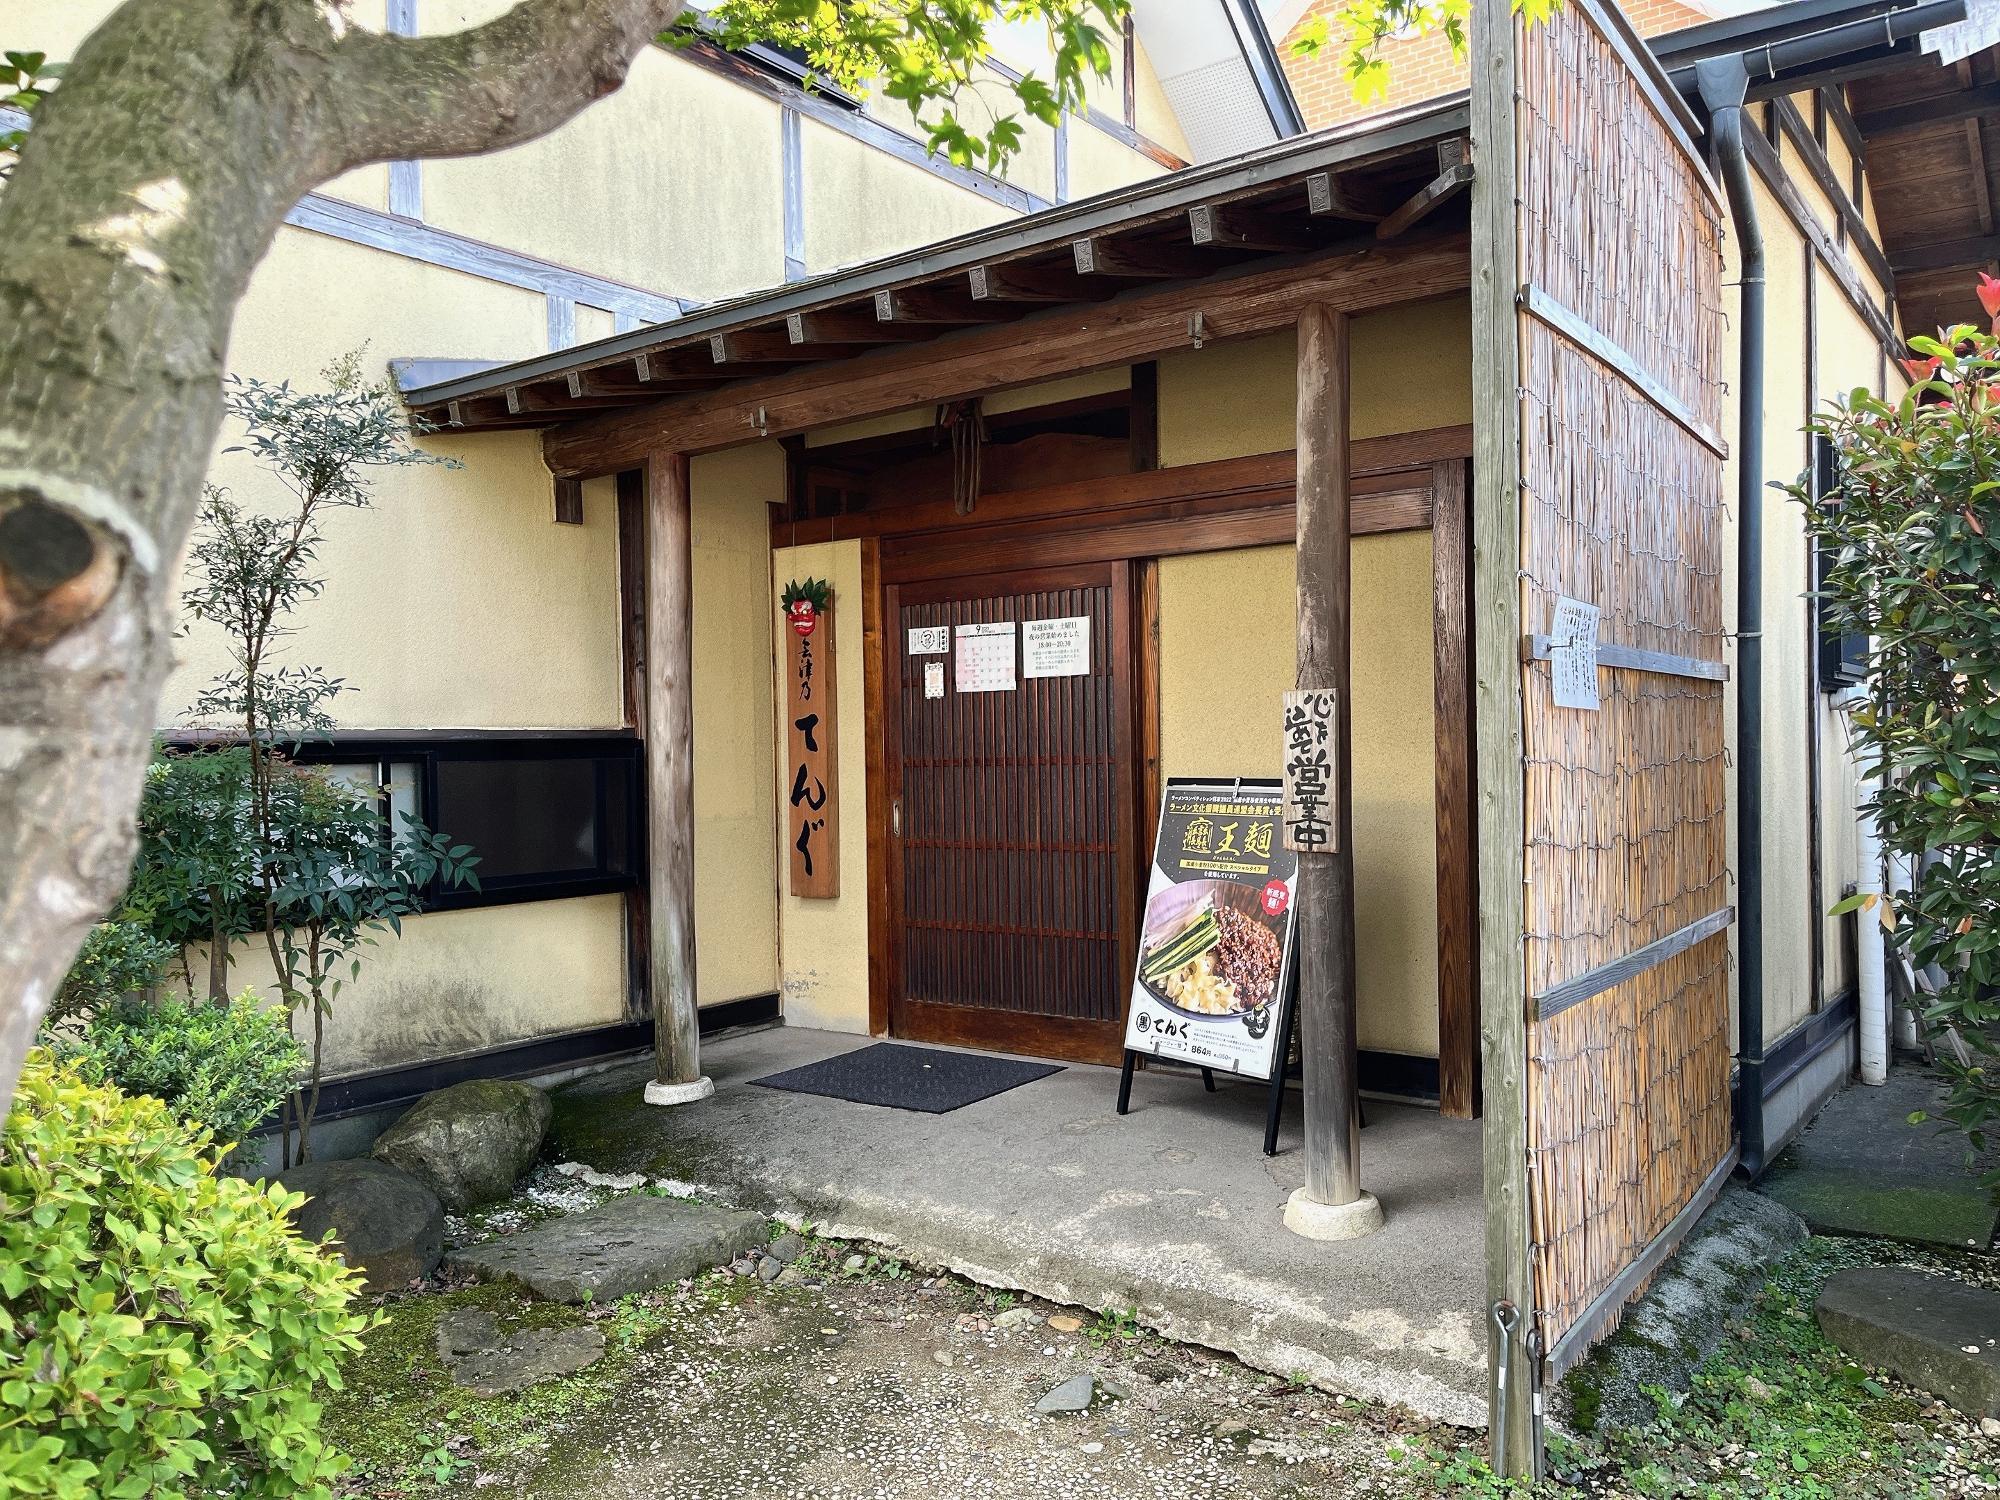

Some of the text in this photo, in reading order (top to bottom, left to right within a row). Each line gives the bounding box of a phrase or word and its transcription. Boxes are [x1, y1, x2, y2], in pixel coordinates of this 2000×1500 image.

[975, 624, 981, 635] 9
[790, 713, 827, 877] てんぐ
[1285, 748, 1332, 852] 営業中
[1169, 802, 1284, 816] ラーメン文化振興議員連盟会長賞を受
[1153, 1018, 1191, 1040] てんぐ
